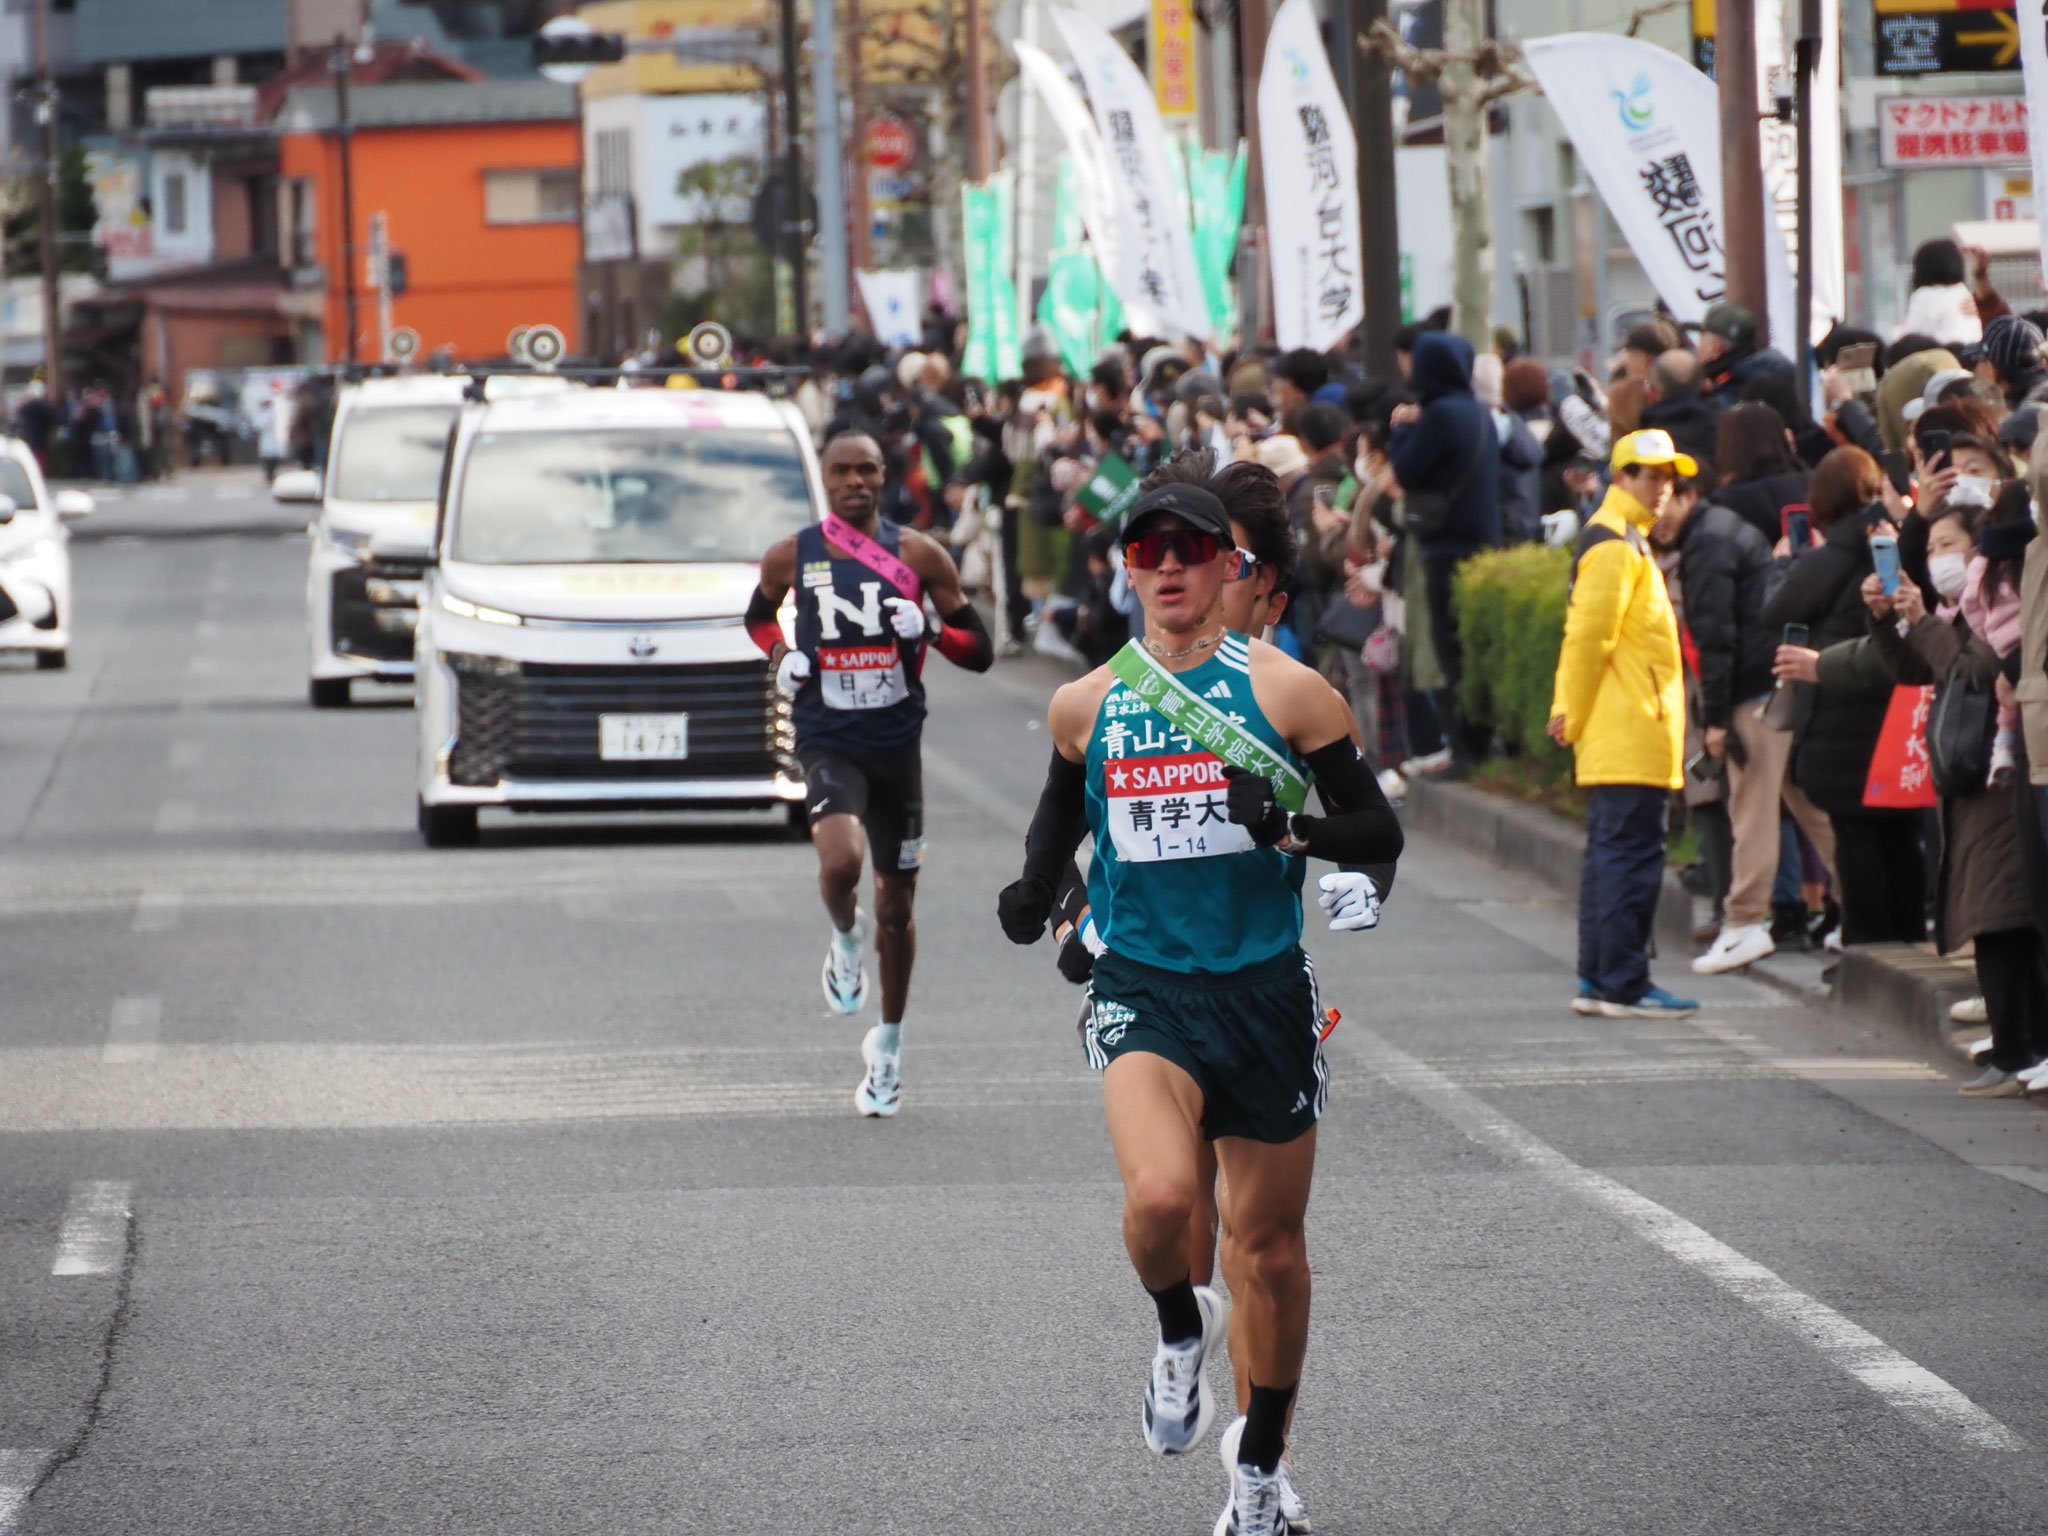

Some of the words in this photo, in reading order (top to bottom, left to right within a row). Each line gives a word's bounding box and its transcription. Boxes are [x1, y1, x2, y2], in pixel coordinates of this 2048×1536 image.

[1882, 14, 1941, 70] 空
[814, 581, 883, 640] N
[1158, 688, 1285, 793] 青山学院大学
[1132, 762, 1229, 790] SAPPOR
[1128, 794, 1226, 832] 青学大
[1152, 834, 1206, 858] 1-14
